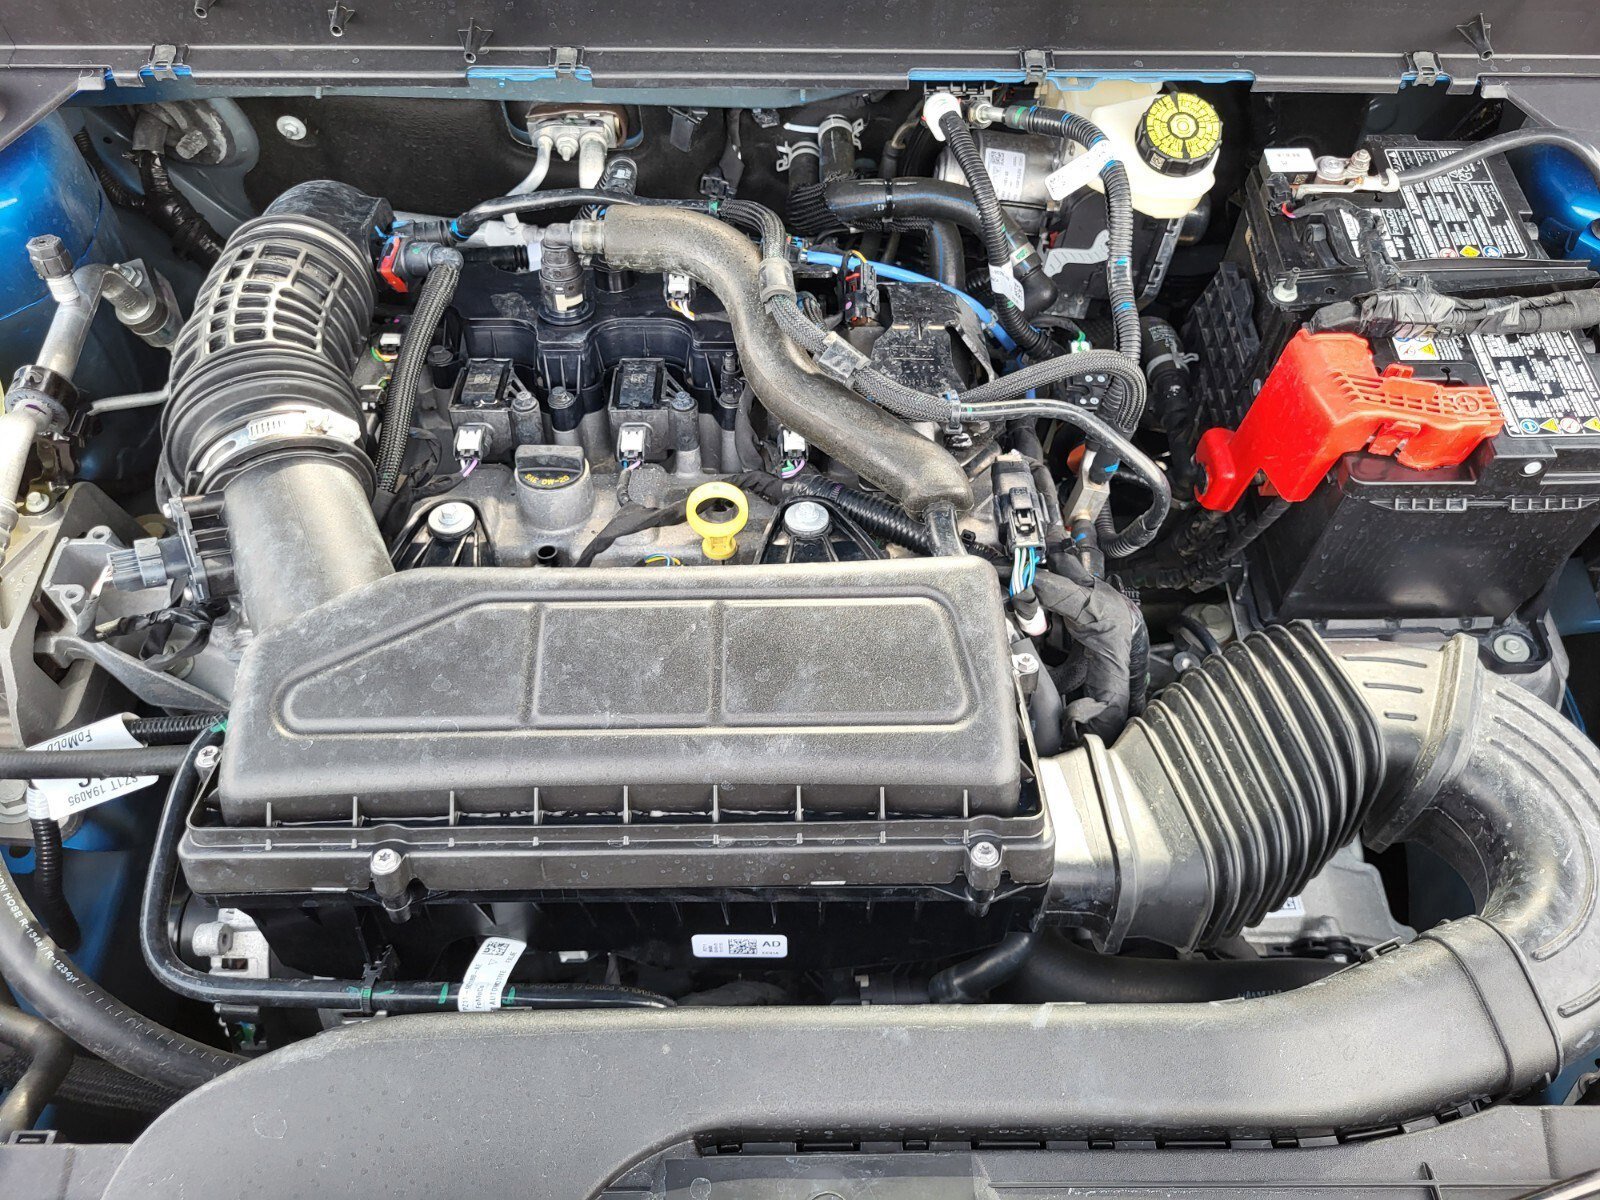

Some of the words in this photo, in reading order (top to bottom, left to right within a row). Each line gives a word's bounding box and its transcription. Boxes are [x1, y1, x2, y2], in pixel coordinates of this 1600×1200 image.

[1385, 209, 1400, 236] FoMoCo
[525, 473, 539, 484] SAE
[541, 475, 570, 485] 0W-20
[68, 786, 106, 806] 19A095
[3, 892, 23, 919] HOSE
